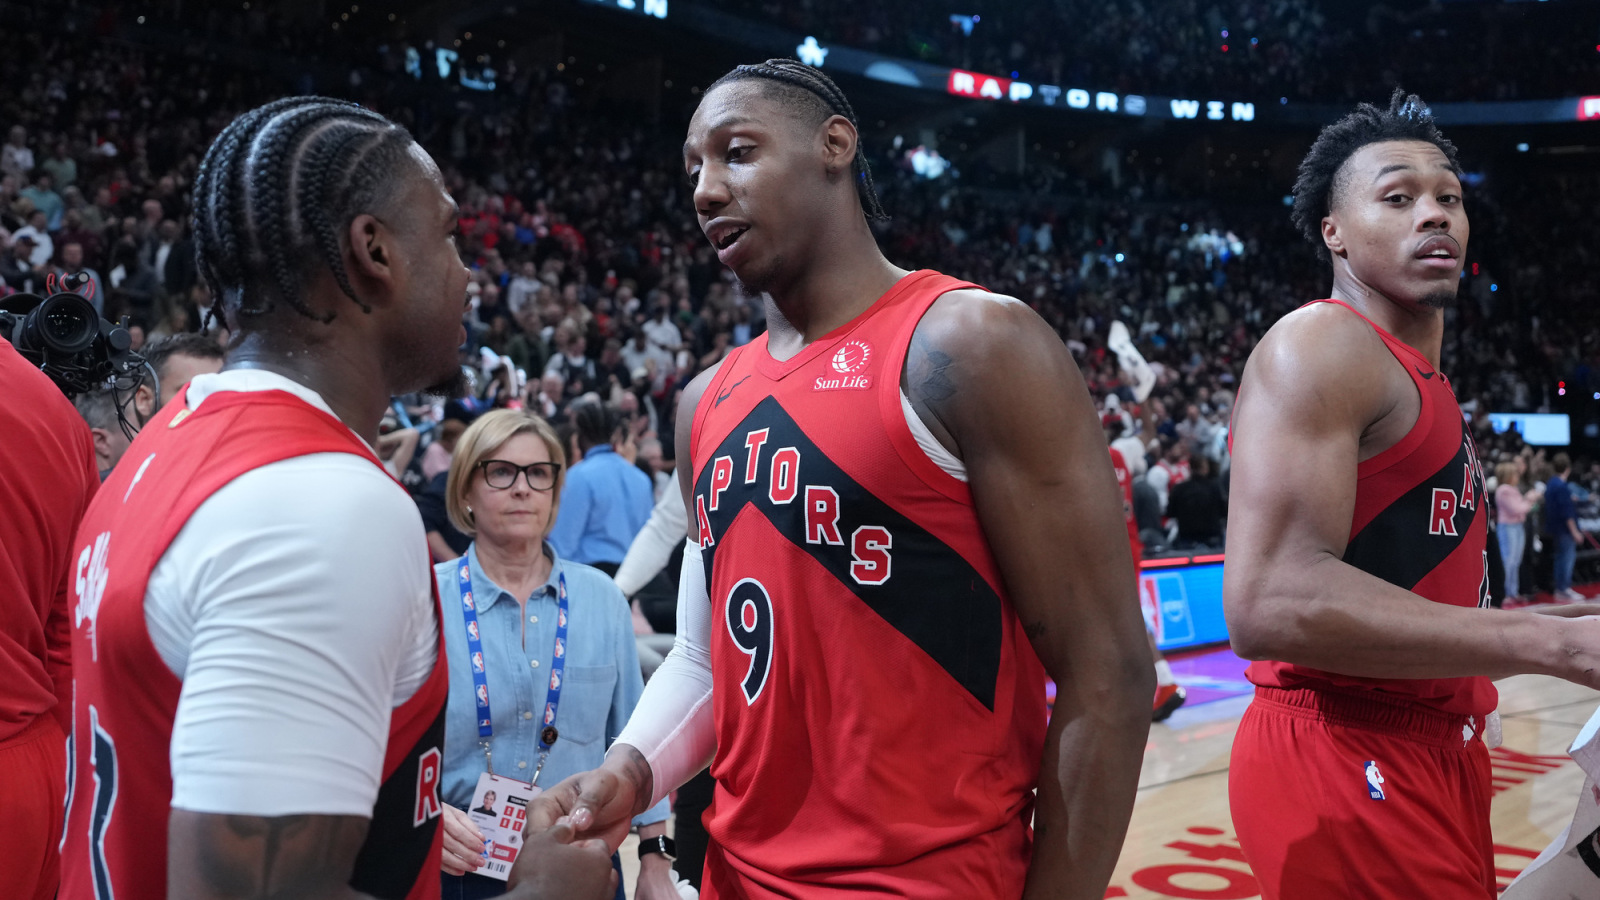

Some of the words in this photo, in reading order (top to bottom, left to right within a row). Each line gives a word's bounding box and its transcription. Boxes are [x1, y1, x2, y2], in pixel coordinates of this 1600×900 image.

[953, 71, 1147, 116] RAPTORS
[1170, 99, 1255, 121] WIN
[814, 377, 840, 390] Sun
[841, 375, 868, 388] Life
[696, 427, 893, 586] APTORS
[725, 577, 774, 706] 9
